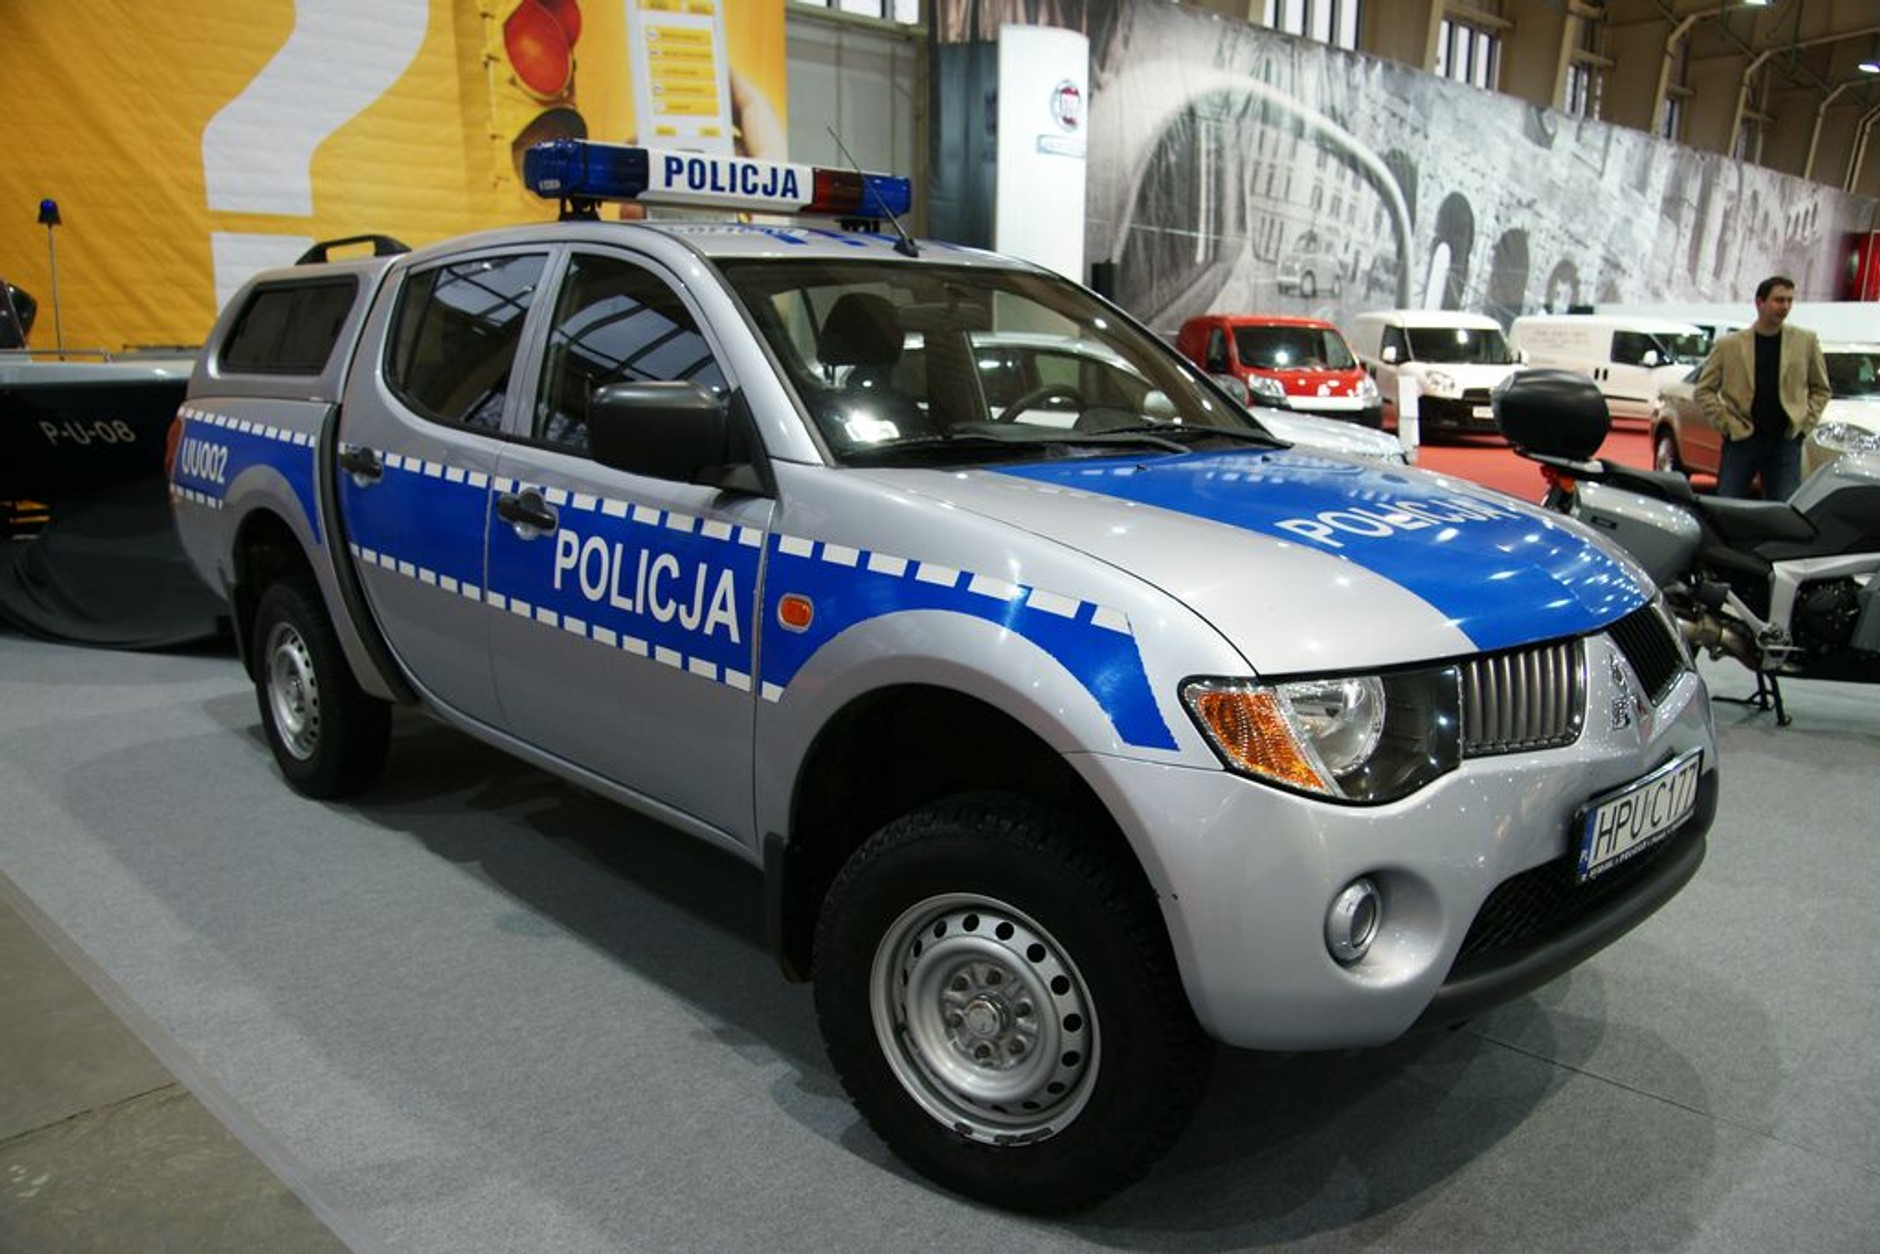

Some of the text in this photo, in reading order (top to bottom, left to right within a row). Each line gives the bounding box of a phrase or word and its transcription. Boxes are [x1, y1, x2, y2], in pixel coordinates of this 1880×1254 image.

[664, 155, 799, 199] POLICJA
[39, 419, 136, 445] P-U-08
[181, 437, 228, 484] UU002
[554, 528, 741, 645] POLICJA
